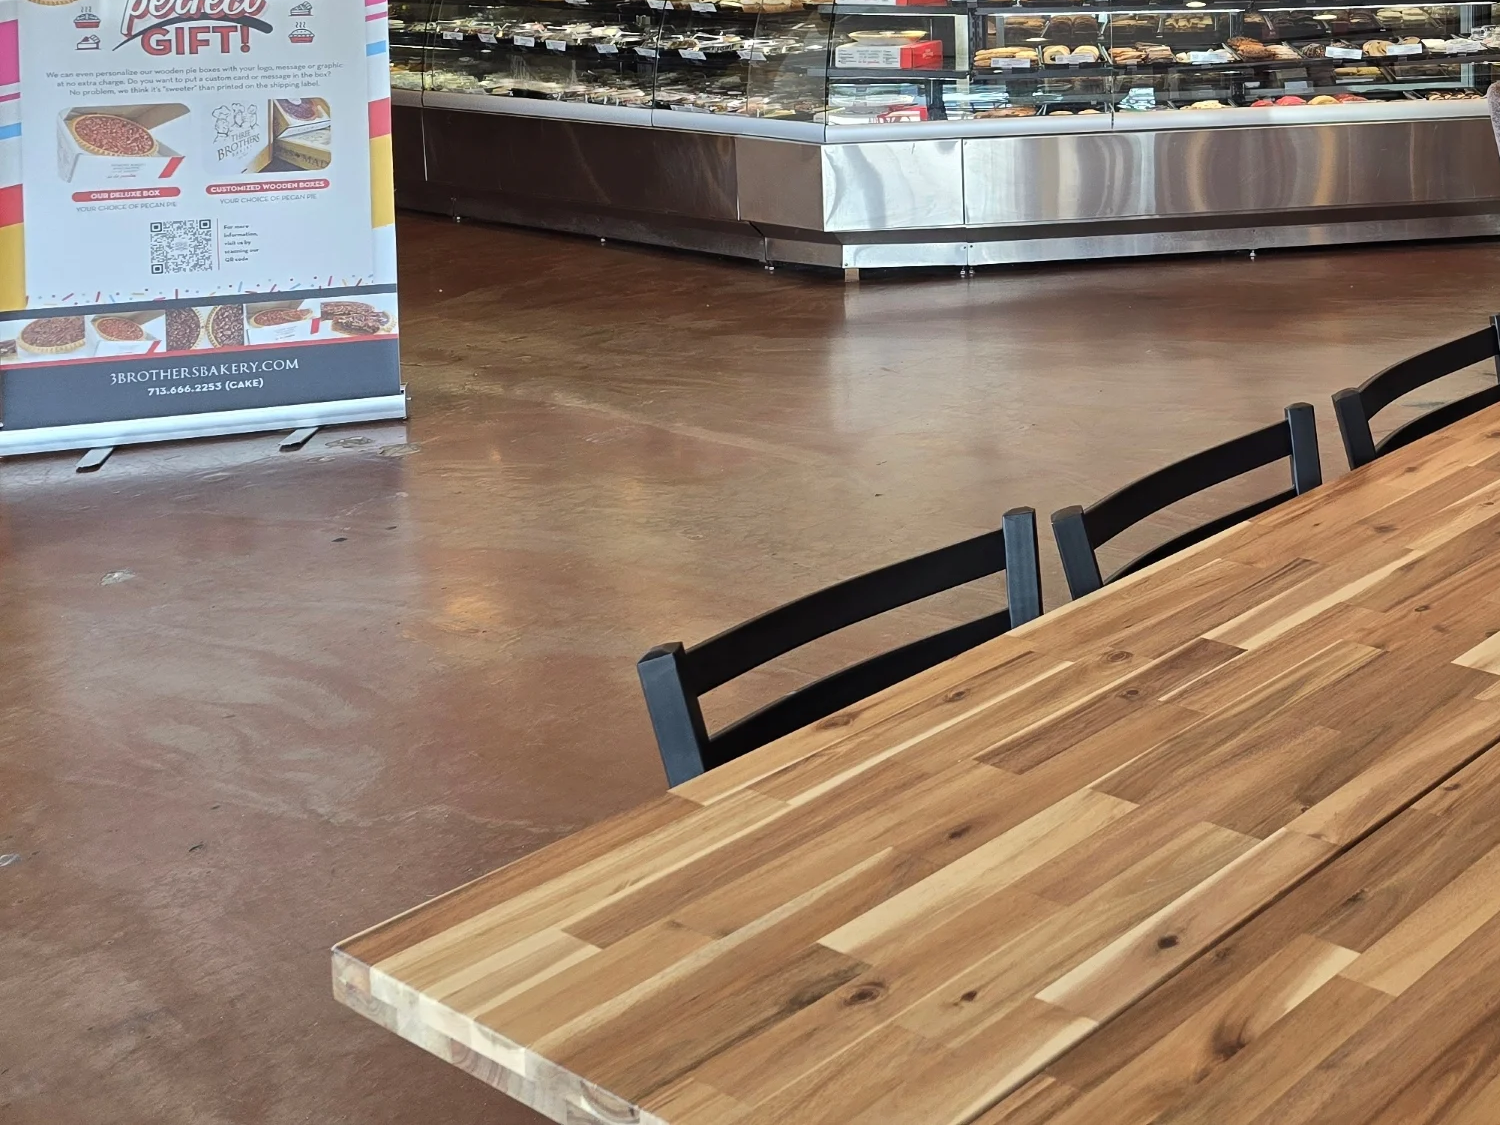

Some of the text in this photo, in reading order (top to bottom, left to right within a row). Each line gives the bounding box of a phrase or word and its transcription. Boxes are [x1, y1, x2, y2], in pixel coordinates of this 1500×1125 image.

[141, 25, 251, 56] GIFT!
[96, 69, 139, 79] personalize
[154, 67, 184, 75] wooden
[186, 68, 197, 76] pie
[199, 66, 221, 74] boxes
[240, 66, 256, 74] your
[316, 62, 344, 72] graphic
[98, 79, 126, 88] charge.
[140, 79, 154, 87] you
[184, 77, 198, 85] put
[232, 73, 250, 81] card
[260, 73, 291, 81] message
[162, 85, 198, 93] "sweeter"
[216, 83, 244, 92] printed
[270, 81, 301, 90] shipping
[231, 129, 251, 142] THREE
[217, 133, 261, 161] BROTHERS
[142, 189, 161, 197] BOX
[210, 185, 261, 193] CUSTOMIZED
[110, 359, 299, 386] 3BROTHERSBAKERY.COM
[148, 378, 264, 396] 713.666.2253 (CAKE)
